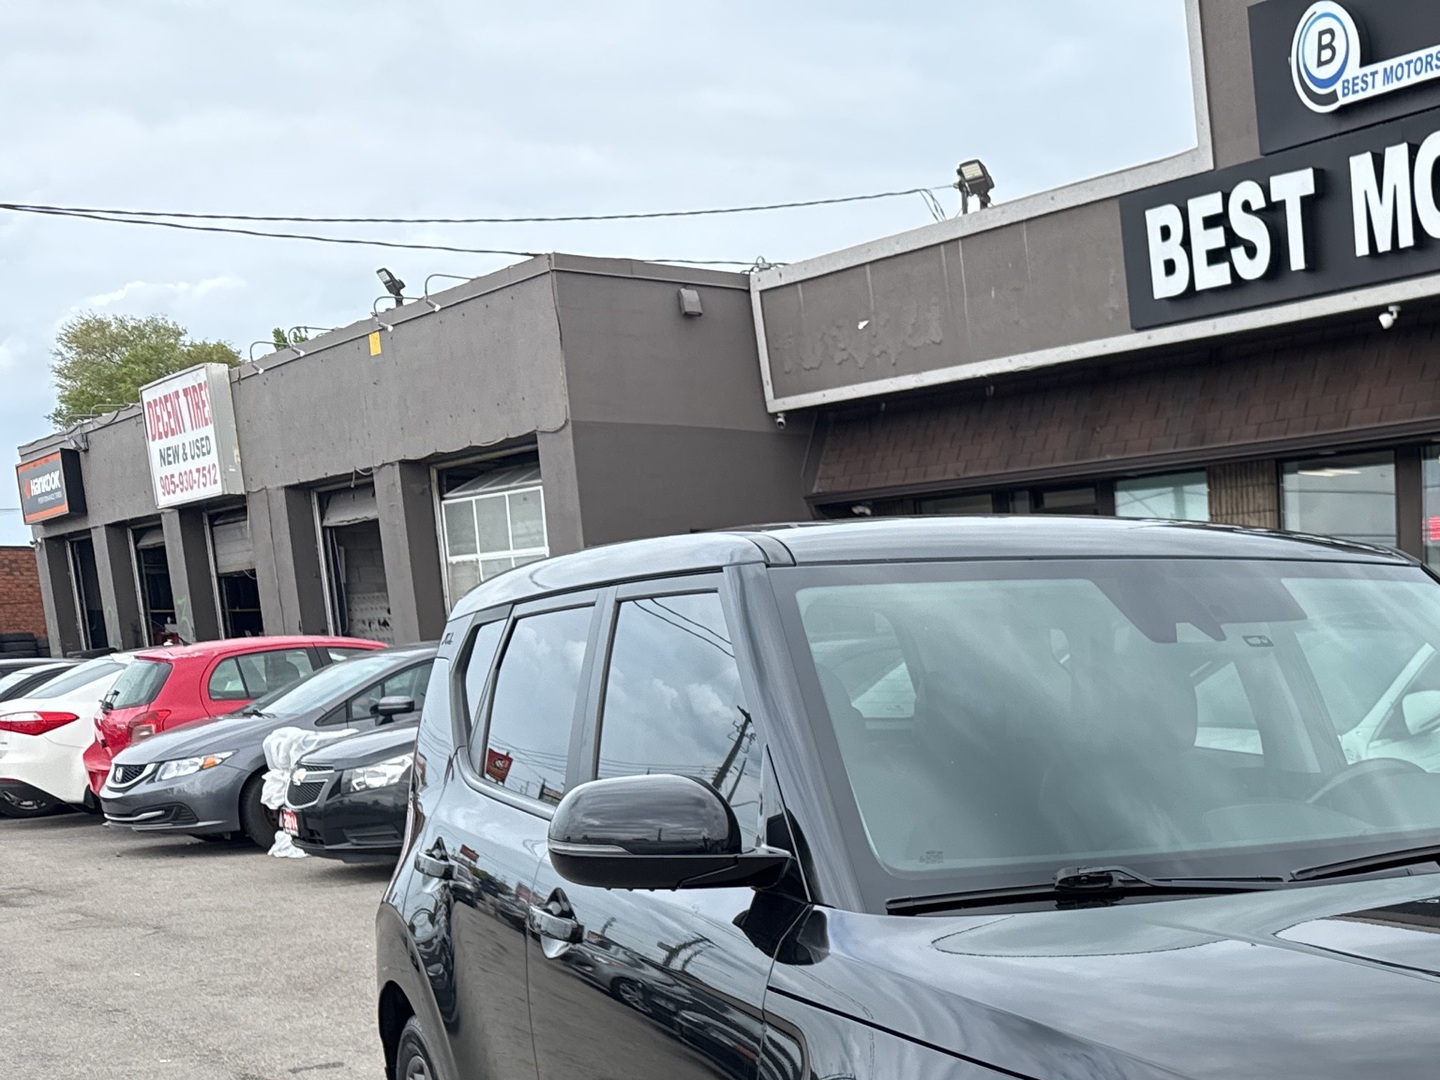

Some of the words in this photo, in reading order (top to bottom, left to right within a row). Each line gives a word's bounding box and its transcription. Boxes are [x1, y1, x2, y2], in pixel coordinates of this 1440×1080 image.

[1316, 27, 1337, 69] B
[1341, 69, 1378, 98] BEST
[1145, 167, 1315, 300] BEST
[146, 390, 186, 442] DECENT
[159, 445, 180, 468] NEW
[182, 442, 189, 462] &
[189, 435, 212, 461] USED
[159, 463, 218, 497] 905-930-7512
